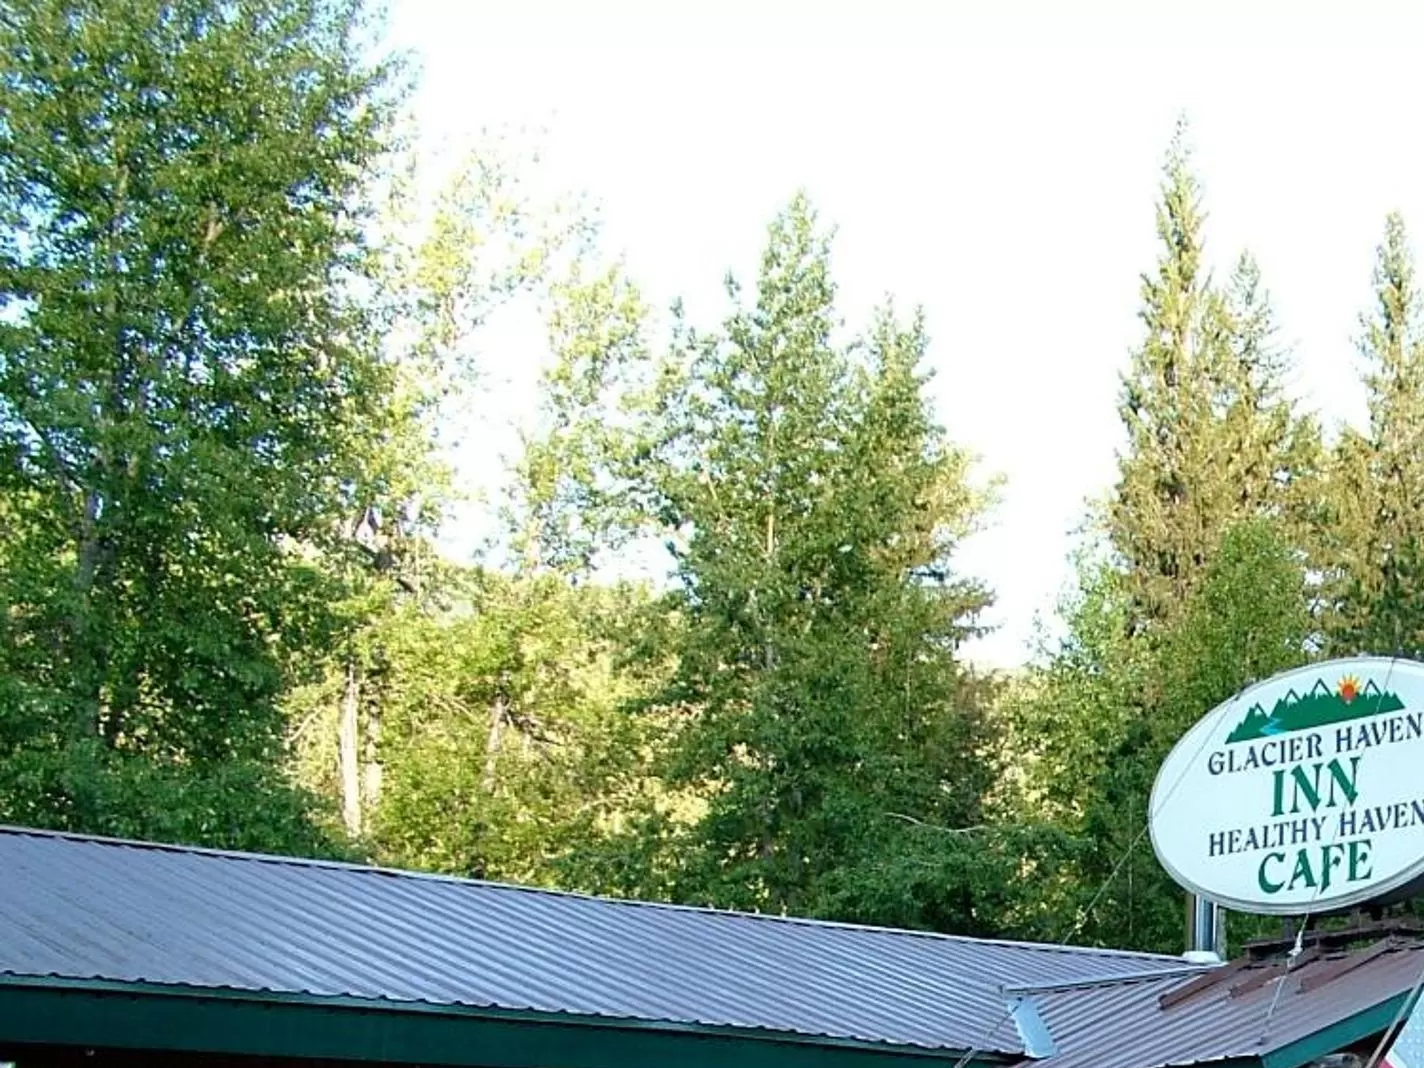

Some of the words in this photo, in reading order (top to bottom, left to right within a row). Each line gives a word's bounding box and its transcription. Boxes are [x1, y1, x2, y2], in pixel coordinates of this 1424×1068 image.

[1208, 733, 1322, 775] GLACIER
[1336, 712, 1422, 753] HAVEN
[1271, 756, 1360, 817] INN
[1208, 815, 1326, 857] HEALTHY
[1258, 839, 1373, 894] CAFE
